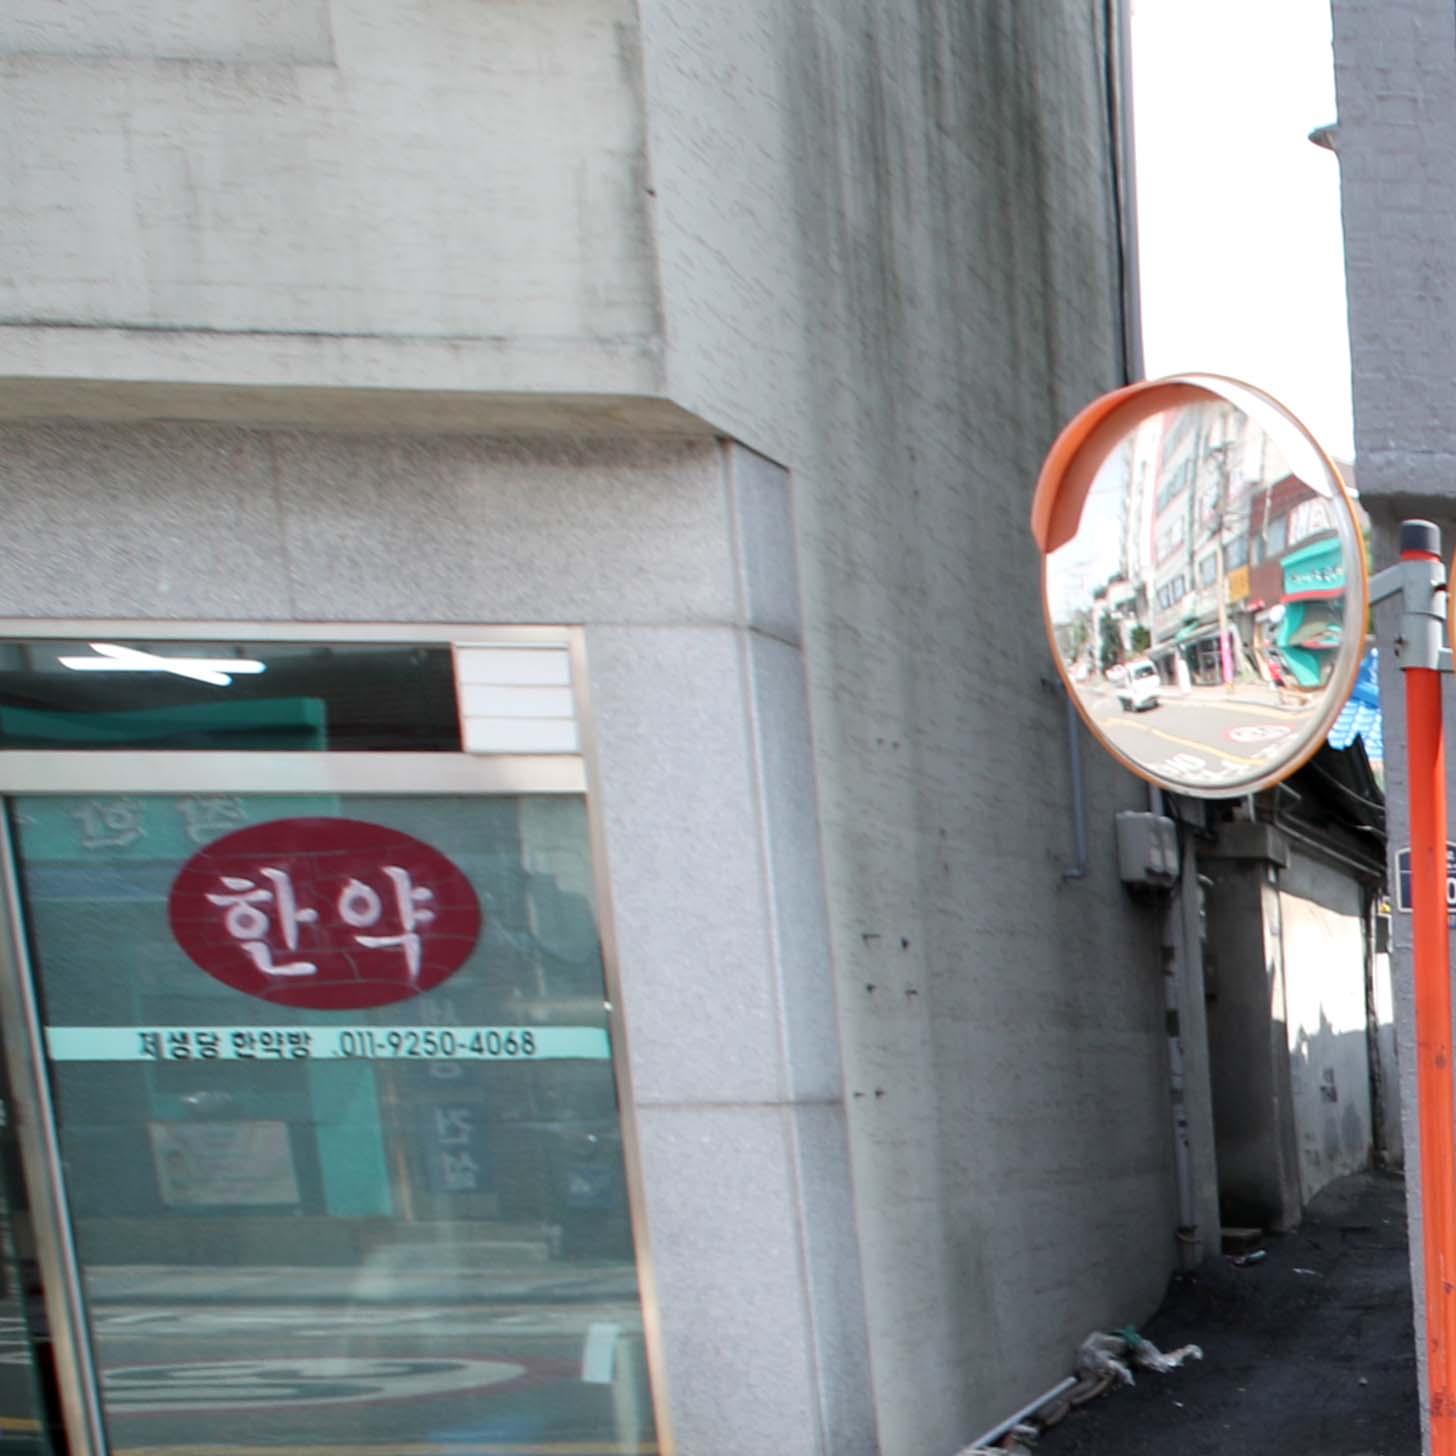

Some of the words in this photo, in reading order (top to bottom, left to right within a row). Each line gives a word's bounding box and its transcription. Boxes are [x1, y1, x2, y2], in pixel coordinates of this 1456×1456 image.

[205, 865, 435, 983] 한약
[138, 1031, 221, 1060] 제생당
[230, 1031, 313, 1059] 한약방
[338, 1031, 536, 1056] 011-9250-4068
